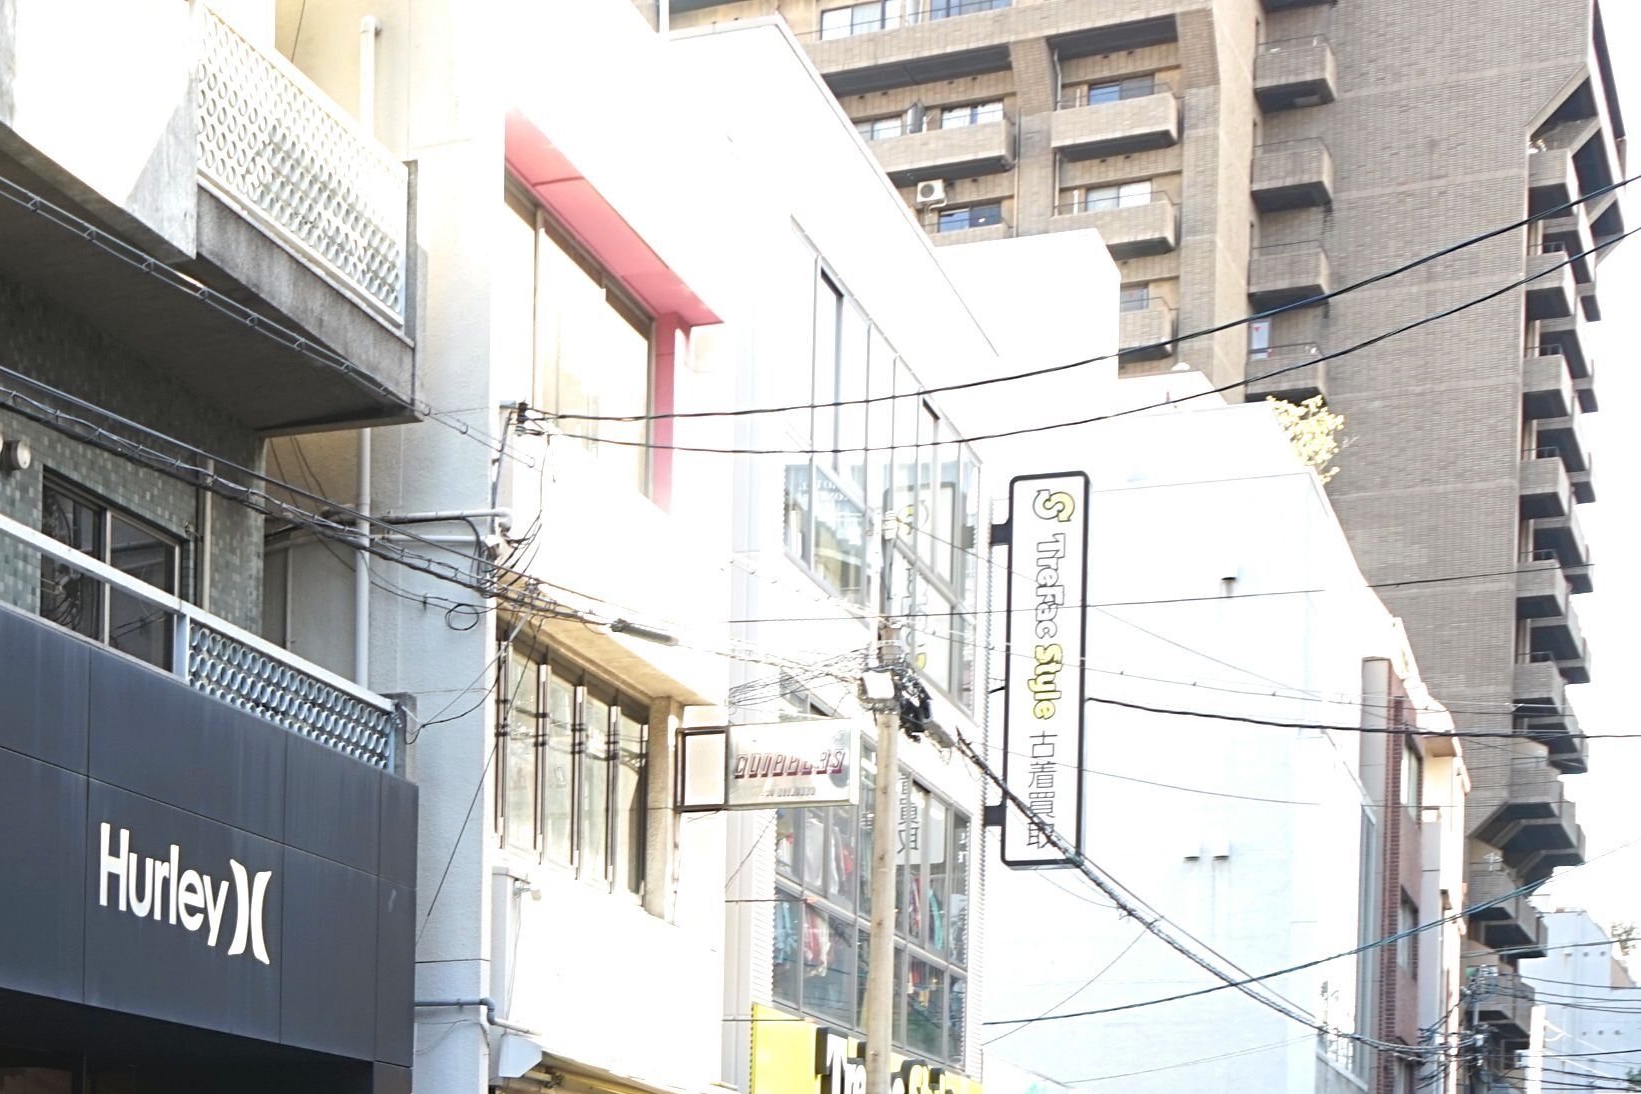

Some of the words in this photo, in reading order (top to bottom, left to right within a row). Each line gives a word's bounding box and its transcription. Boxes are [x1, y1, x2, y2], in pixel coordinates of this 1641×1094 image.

[1027, 643, 1063, 720] Style
[1027, 731, 1058, 849] 古着買取
[99, 822, 229, 946] Hurley
